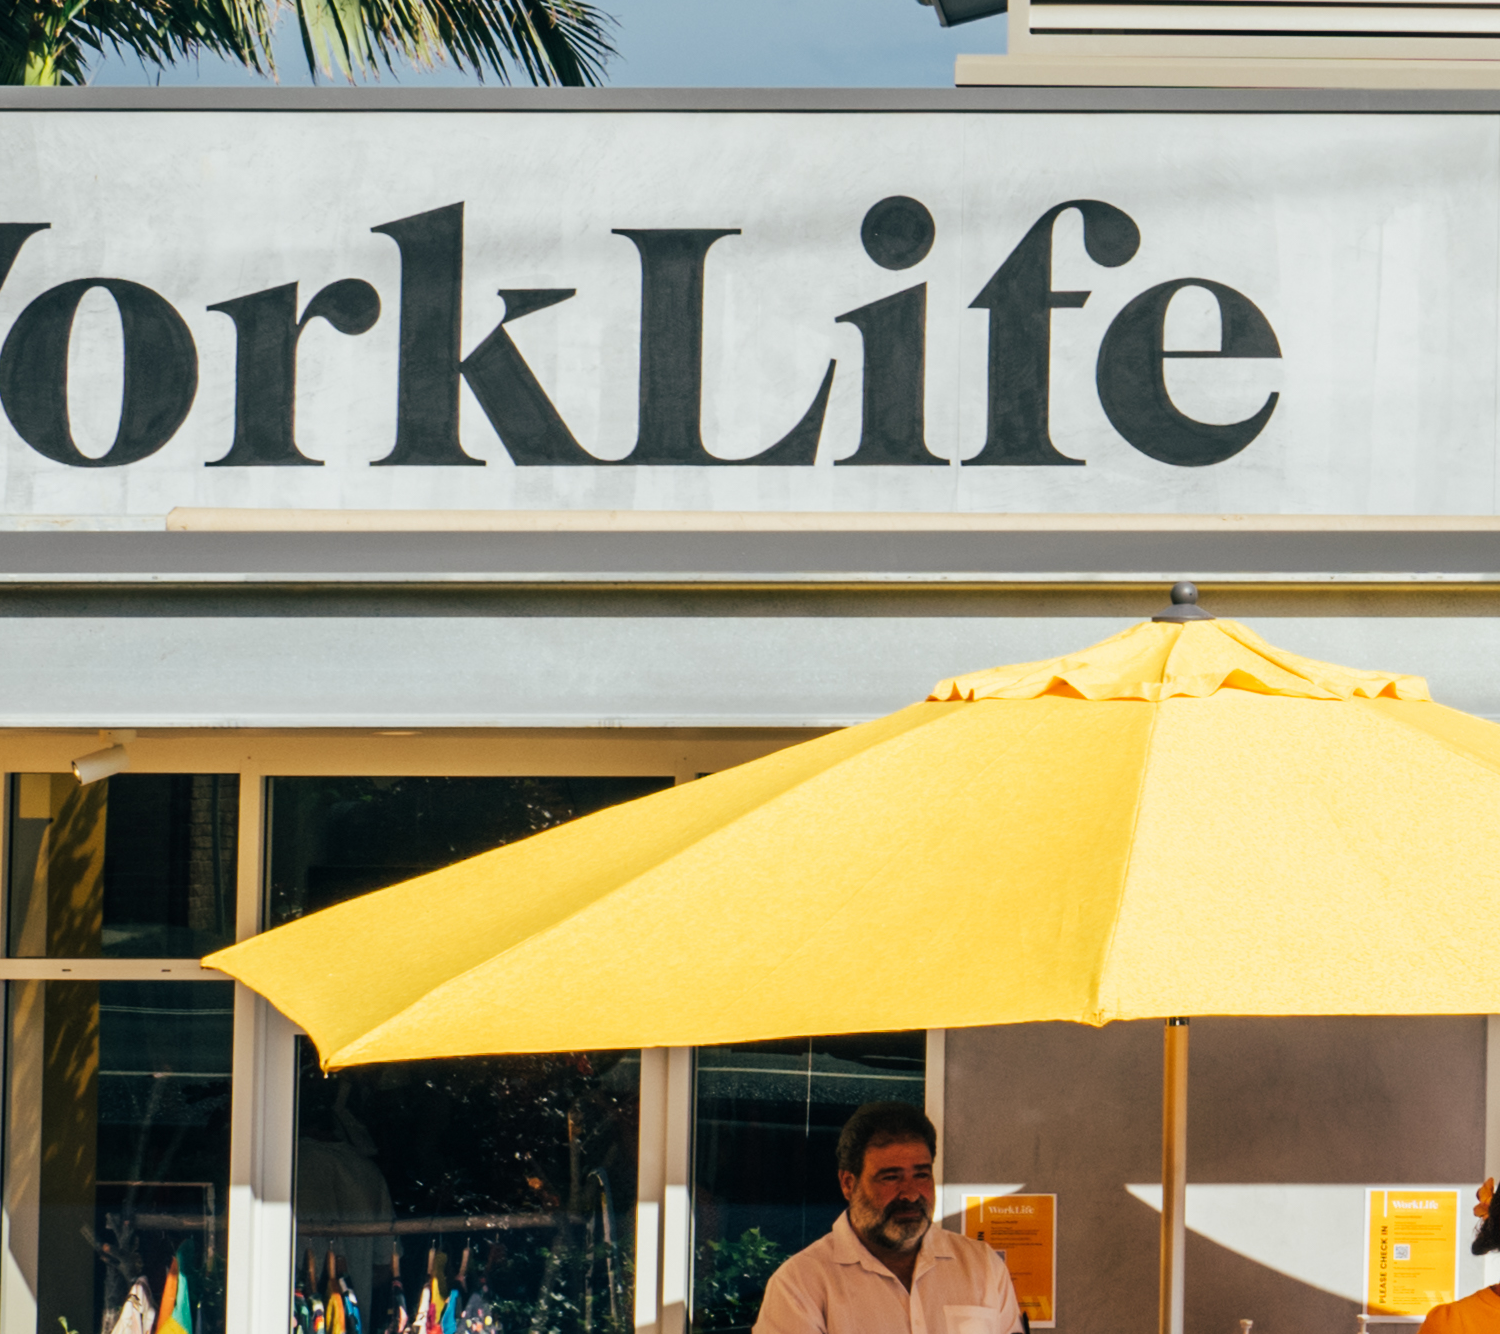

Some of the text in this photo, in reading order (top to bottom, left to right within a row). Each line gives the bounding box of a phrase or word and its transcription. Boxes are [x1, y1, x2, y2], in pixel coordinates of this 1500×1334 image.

[988, 1204, 1035, 1215] WorkLife
[1392, 1199, 1439, 1210] WorkLife
[1379, 1225, 1388, 1304] PLEASE CHECK IN
